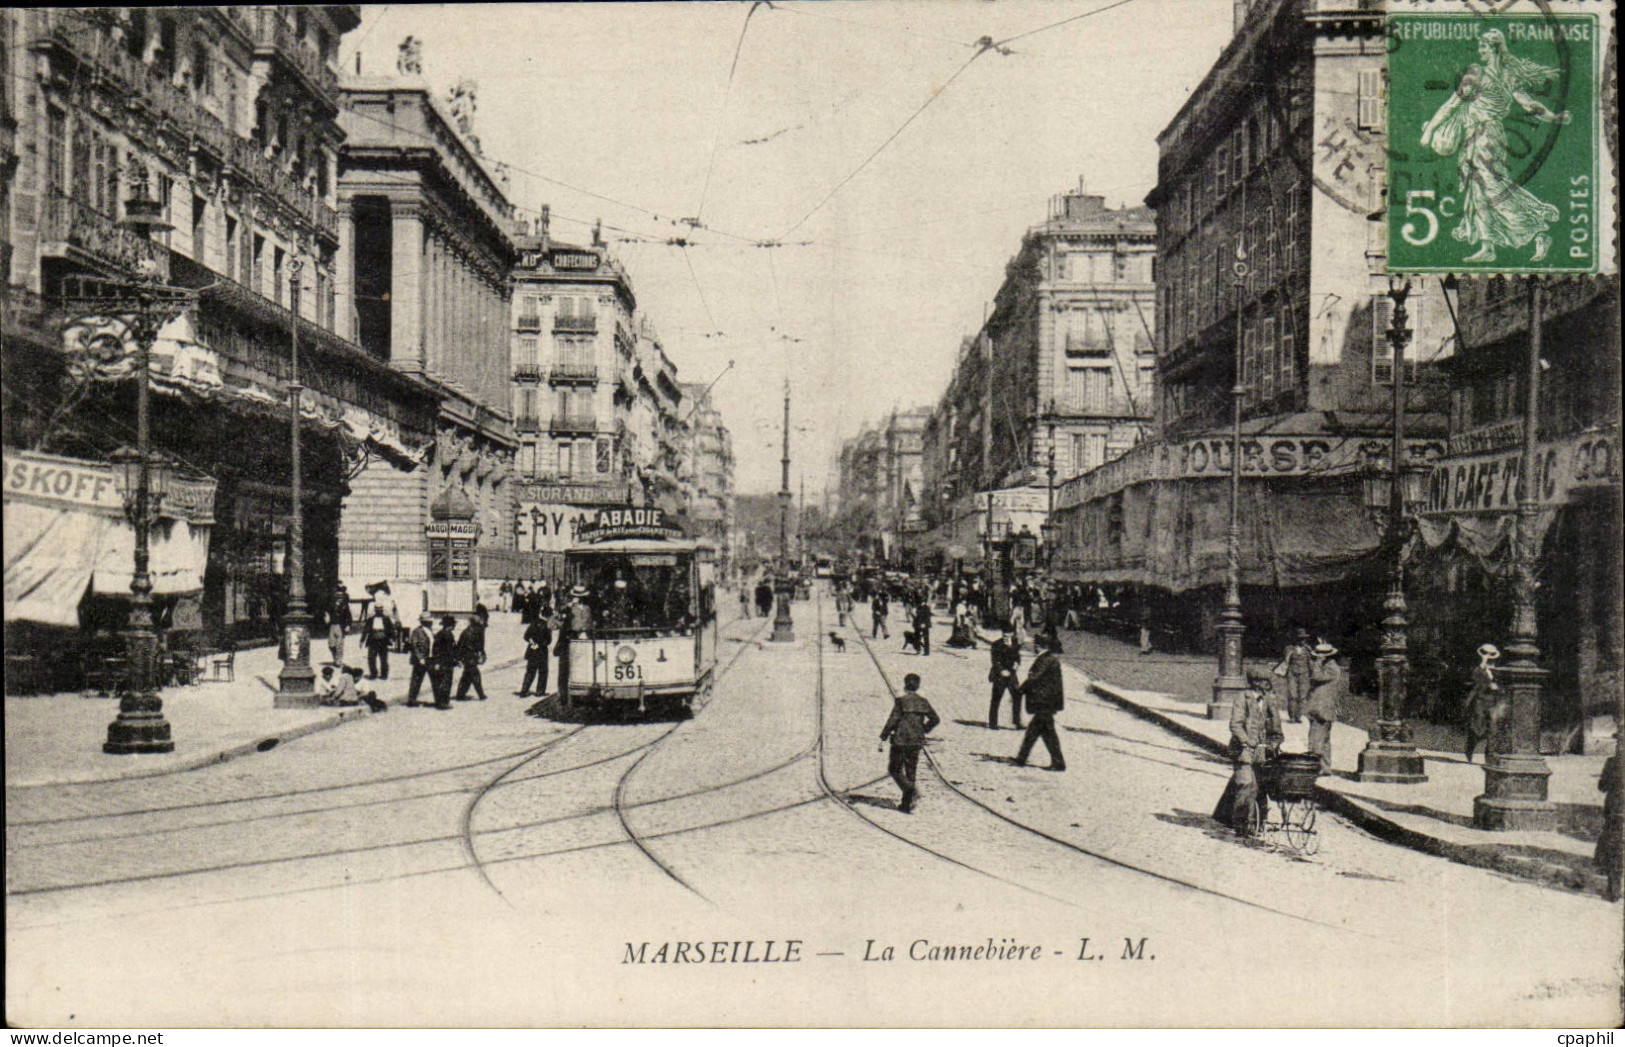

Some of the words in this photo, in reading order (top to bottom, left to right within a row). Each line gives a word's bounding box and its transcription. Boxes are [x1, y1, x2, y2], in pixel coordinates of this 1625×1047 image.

[1570, 174, 1590, 258] POSTES
[3, 461, 113, 501] SKOFF
[600, 509, 662, 528] ABADIE
[450, 525, 476, 533] MAGGI
[614, 665, 643, 680] 561
